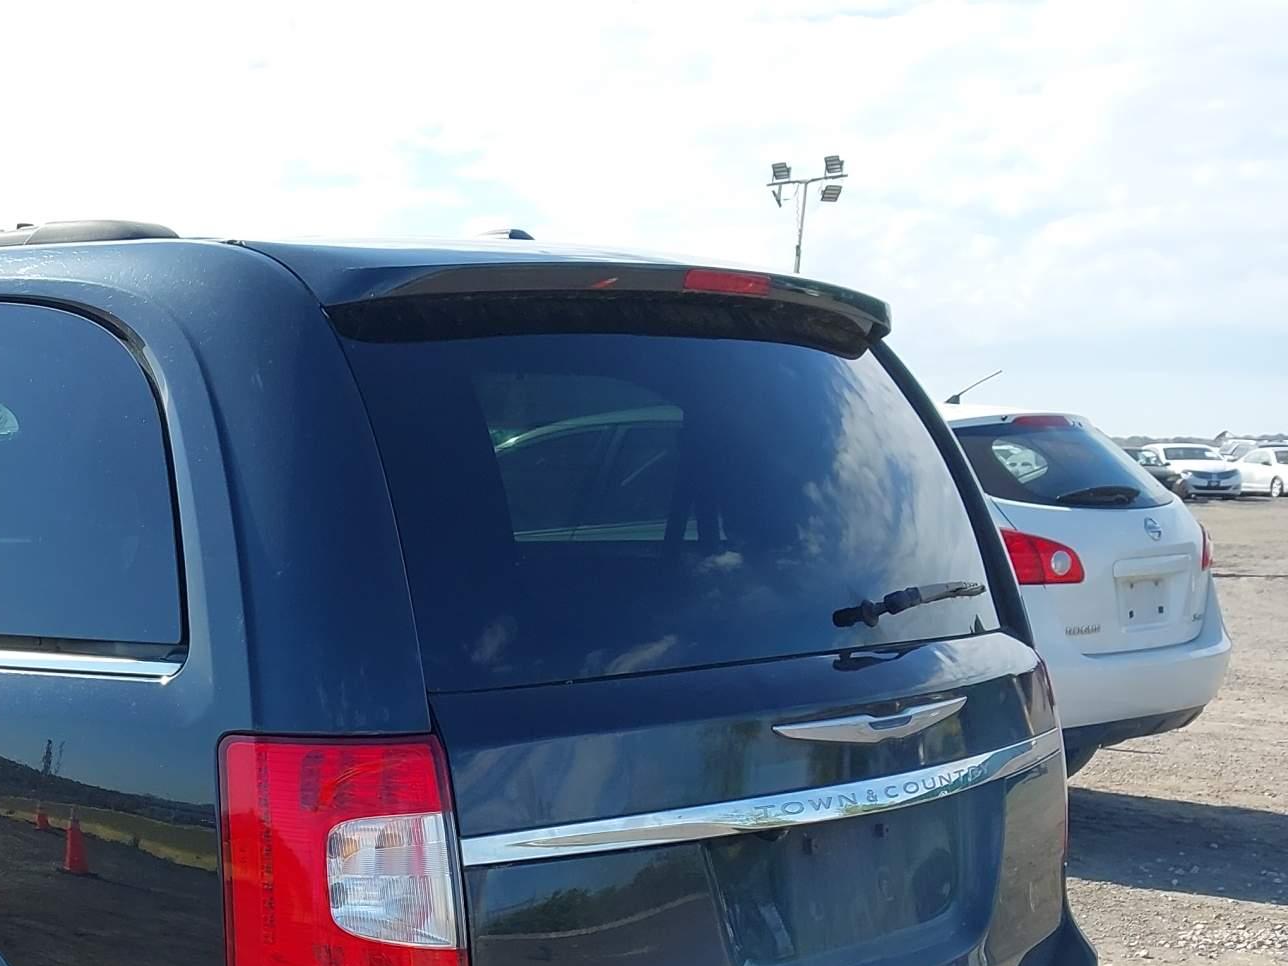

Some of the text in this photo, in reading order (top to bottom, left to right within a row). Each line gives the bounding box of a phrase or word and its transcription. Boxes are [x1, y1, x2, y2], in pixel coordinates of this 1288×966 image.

[754, 762, 989, 818] TOWN & COUNTRY
